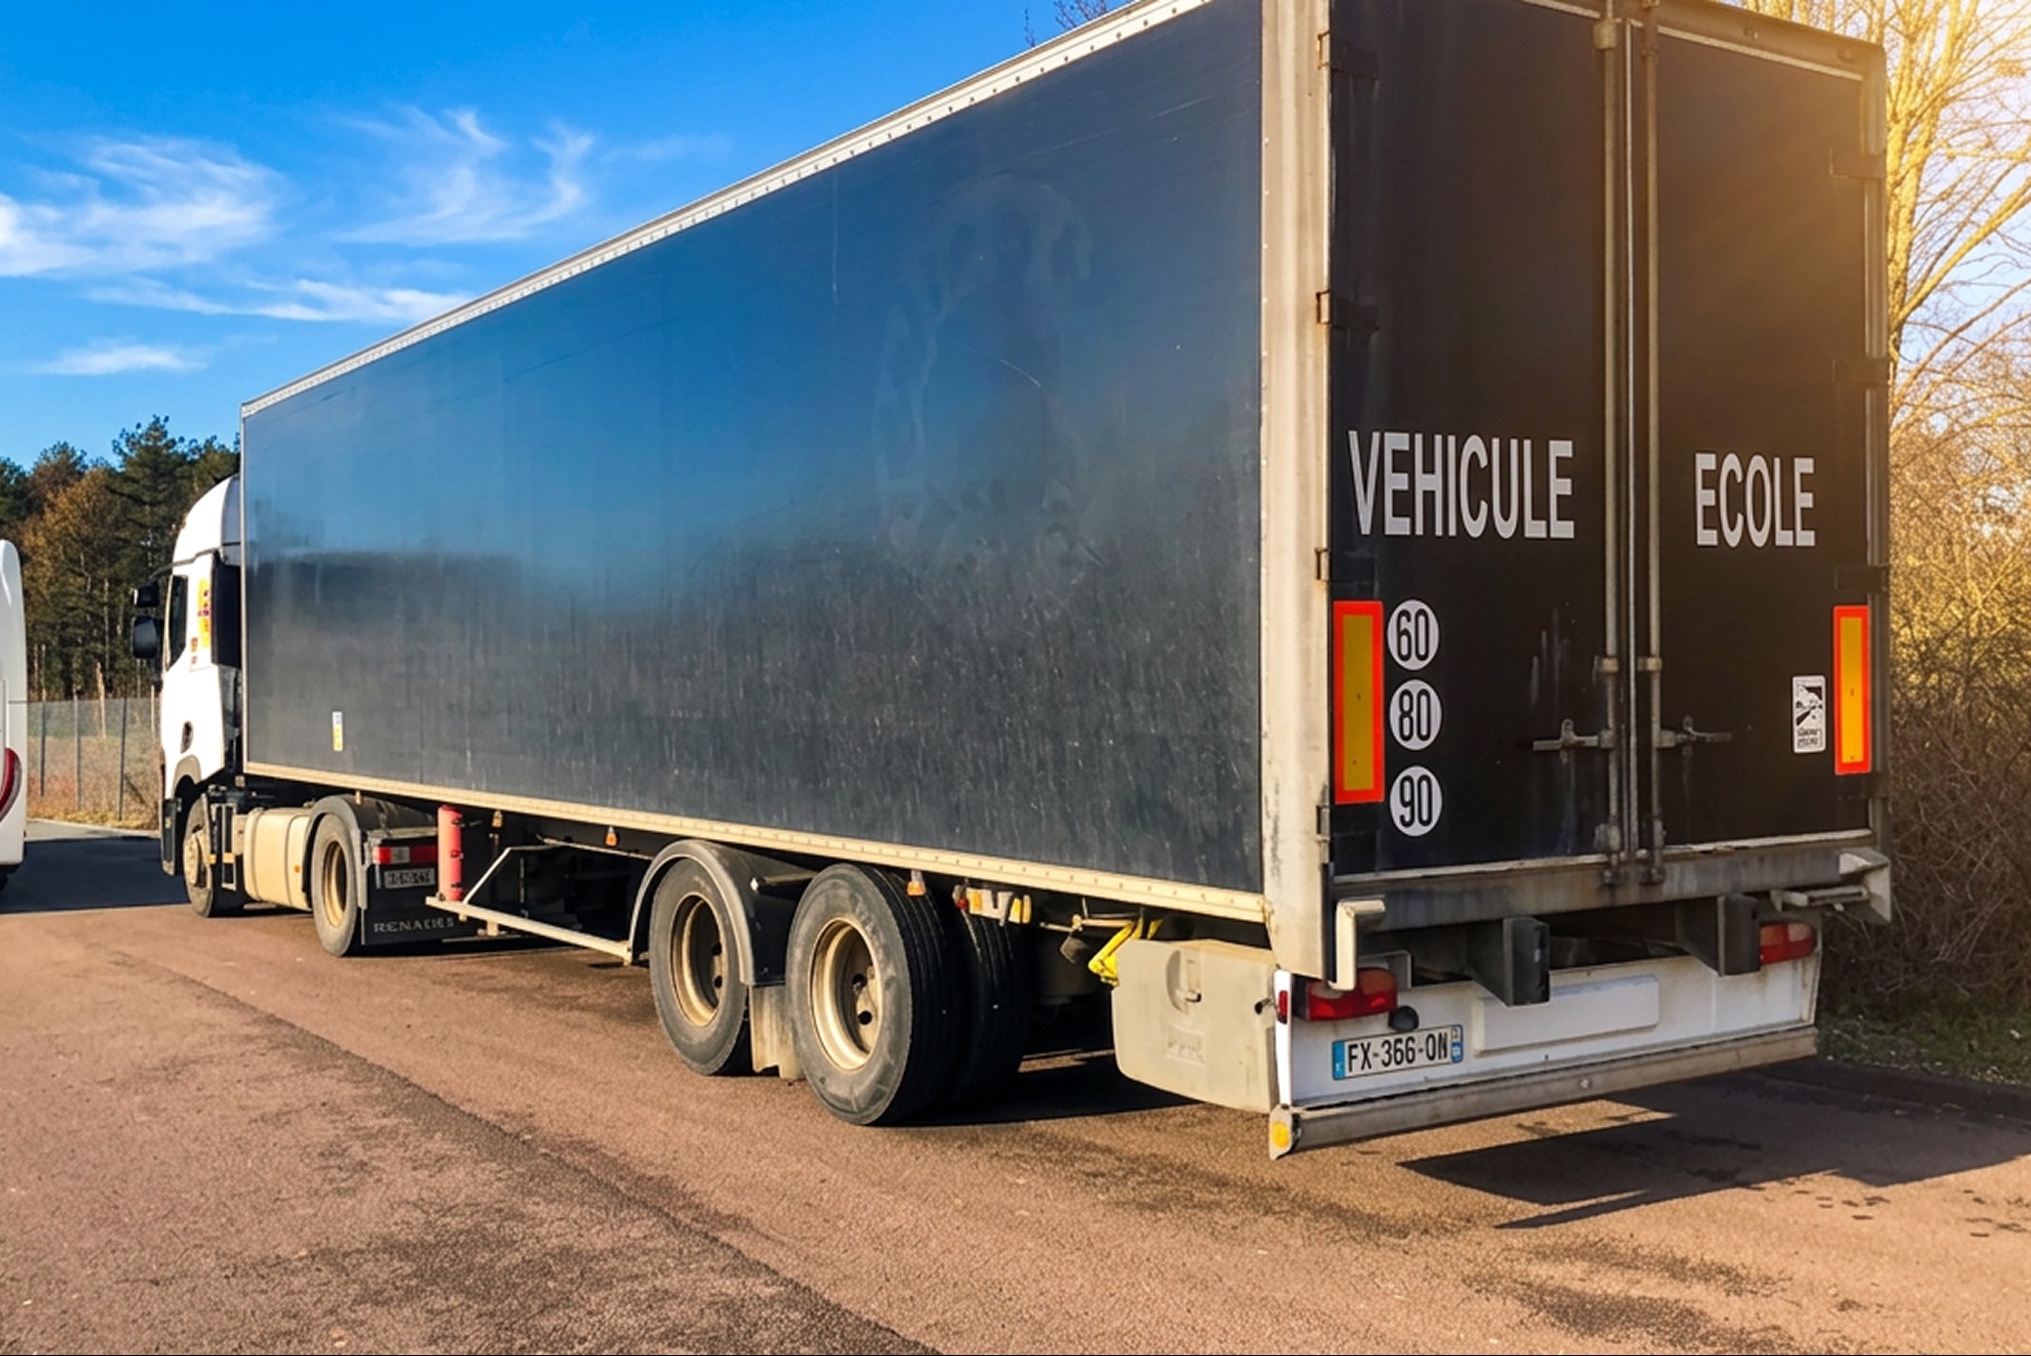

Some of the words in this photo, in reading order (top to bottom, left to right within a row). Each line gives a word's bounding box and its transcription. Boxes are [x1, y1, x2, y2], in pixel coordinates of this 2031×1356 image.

[1348, 430, 1575, 539] VEHICULE
[1695, 452, 1815, 547] ECOLE
[1396, 608, 1430, 662] 60
[1399, 689, 1431, 742] 80
[1400, 774, 1433, 828] 90
